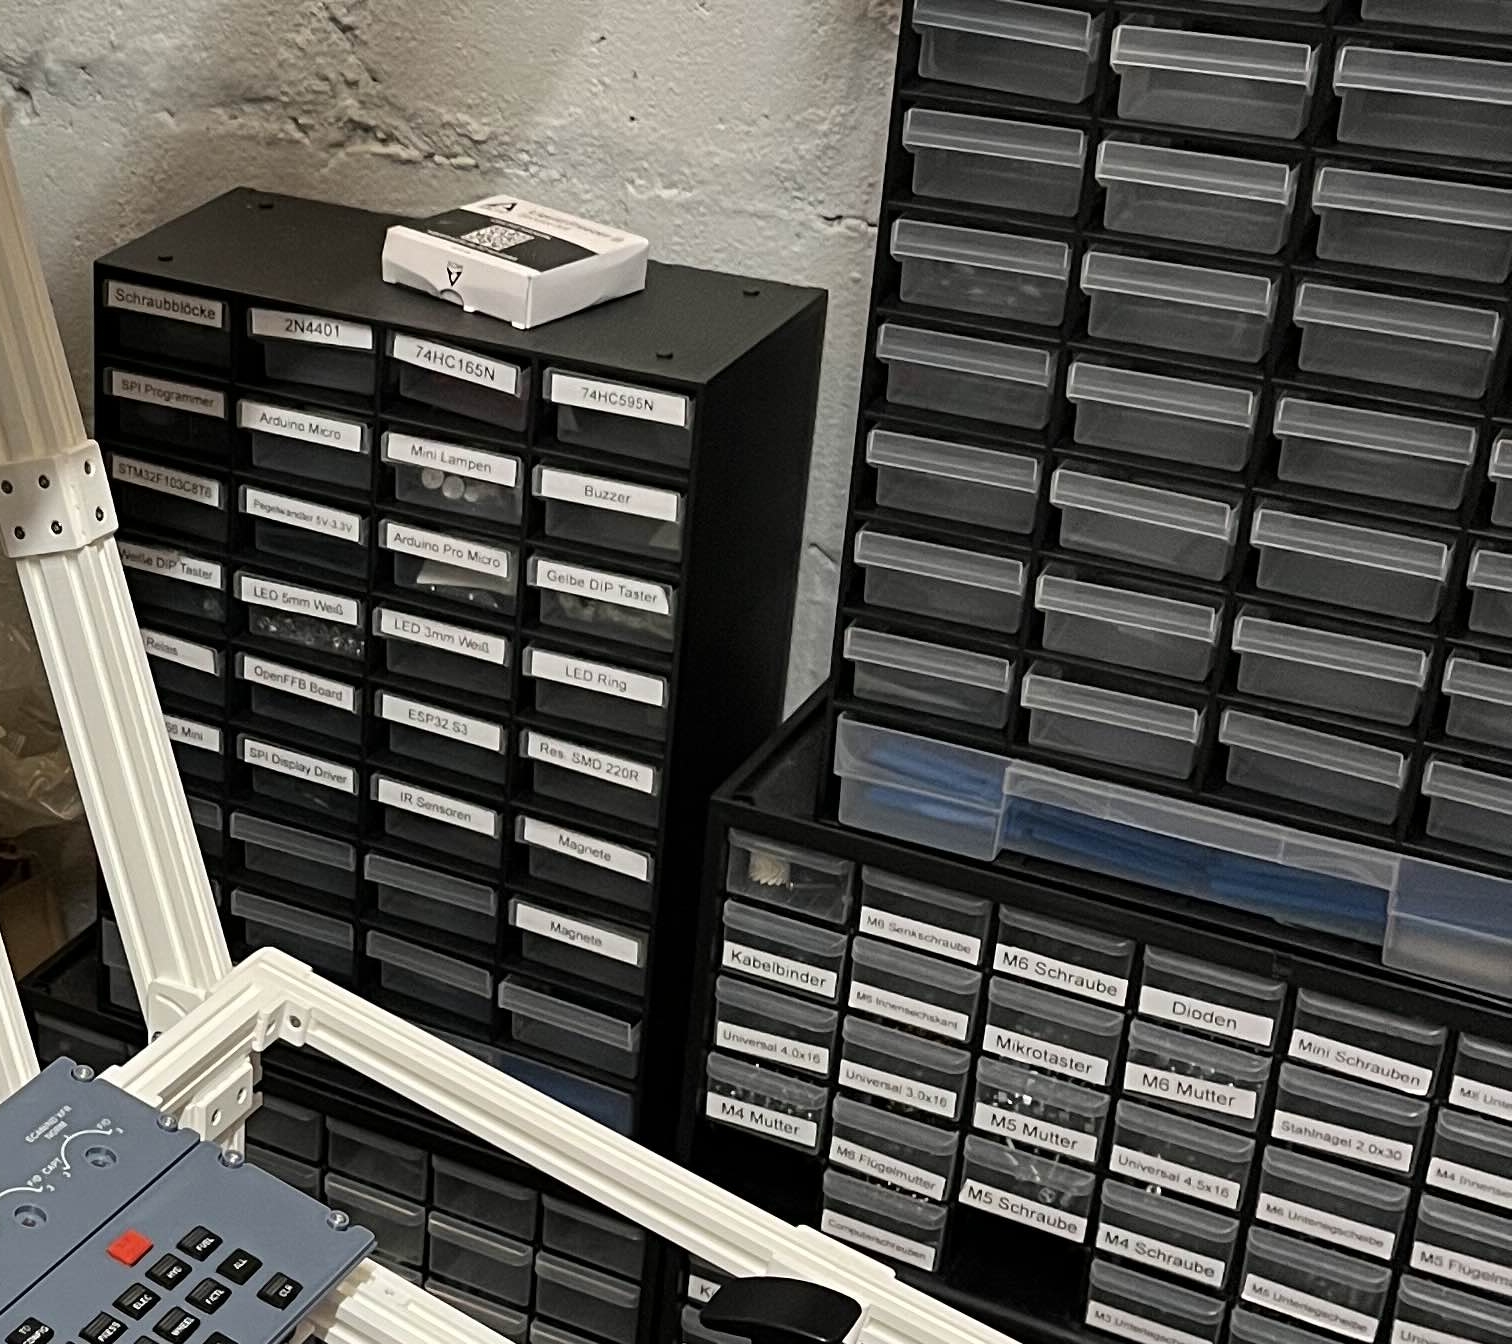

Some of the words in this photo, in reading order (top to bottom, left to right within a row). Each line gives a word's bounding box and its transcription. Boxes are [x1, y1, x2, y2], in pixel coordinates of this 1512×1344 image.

[284, 318, 340, 338] 2N4401
[415, 345, 496, 381] 74HC165N
[121, 379, 142, 393] SPI
[145, 385, 215, 407] Programmer
[581, 387, 654, 411] 74HC595N
[260, 412, 305, 432] Arduino
[309, 422, 342, 441] Micro
[410, 444, 437, 461] Mini
[441, 448, 492, 474] Lampen
[584, 485, 631, 504] Buzzer
[394, 531, 439, 553] Arduino
[443, 543, 463, 559] Pro
[468, 551, 501, 569] Micro
[282, 591, 310, 609] 5mm
[546, 569, 585, 588] Gelbe
[618, 585, 657, 604] Taster
[394, 619, 421, 635] LED
[425, 626, 455, 643] 3mm
[254, 665, 306, 690] OpenFFB
[310, 681, 343, 701] Board
[565, 664, 593, 681] LED
[598, 671, 627, 692] Ring
[408, 709, 449, 732] ESP32
[452, 720, 469, 736] S3
[249, 747, 269, 759] SPI
[272, 753, 311, 776] Display
[314, 765, 347, 784] Driver
[571, 752, 602, 770] SMD
[606, 763, 639, 782] 220R
[400, 791, 413, 804] IR
[416, 797, 471, 823] Sensoren
[558, 834, 611, 862] Magnete
[550, 921, 603, 947] Magnete
[888, 922, 972, 954] Senkschraube
[730, 950, 826, 988] Kabelbinder
[1002, 951, 1029, 970] M6
[1034, 961, 1118, 997] Schraube
[1172, 1001, 1237, 1030] Dioden
[722, 1030, 778, 1054] Universal
[996, 1034, 1093, 1075] Mikrotaster
[1298, 1038, 1330, 1059] Mini
[1335, 1051, 1421, 1087] Schrauben
[846, 1070, 903, 1098] Universal
[1142, 1073, 1170, 1091] M6
[1176, 1081, 1236, 1107] Mutter
[721, 1102, 744, 1120] M4
[750, 1110, 800, 1135] Mutter
[990, 1112, 1017, 1131] M5
[1022, 1122, 1078, 1149] Mutter
[42, 1157, 62, 1176] CAPT
[1118, 1155, 1180, 1183] Universal
[967, 1186, 993, 1204] M5
[998, 1194, 1078, 1234] Schraube
[196, 1236, 215, 1252] FUEL
[1104, 1231, 1130, 1250] M4
[1134, 1241, 1215, 1278] Schraube
